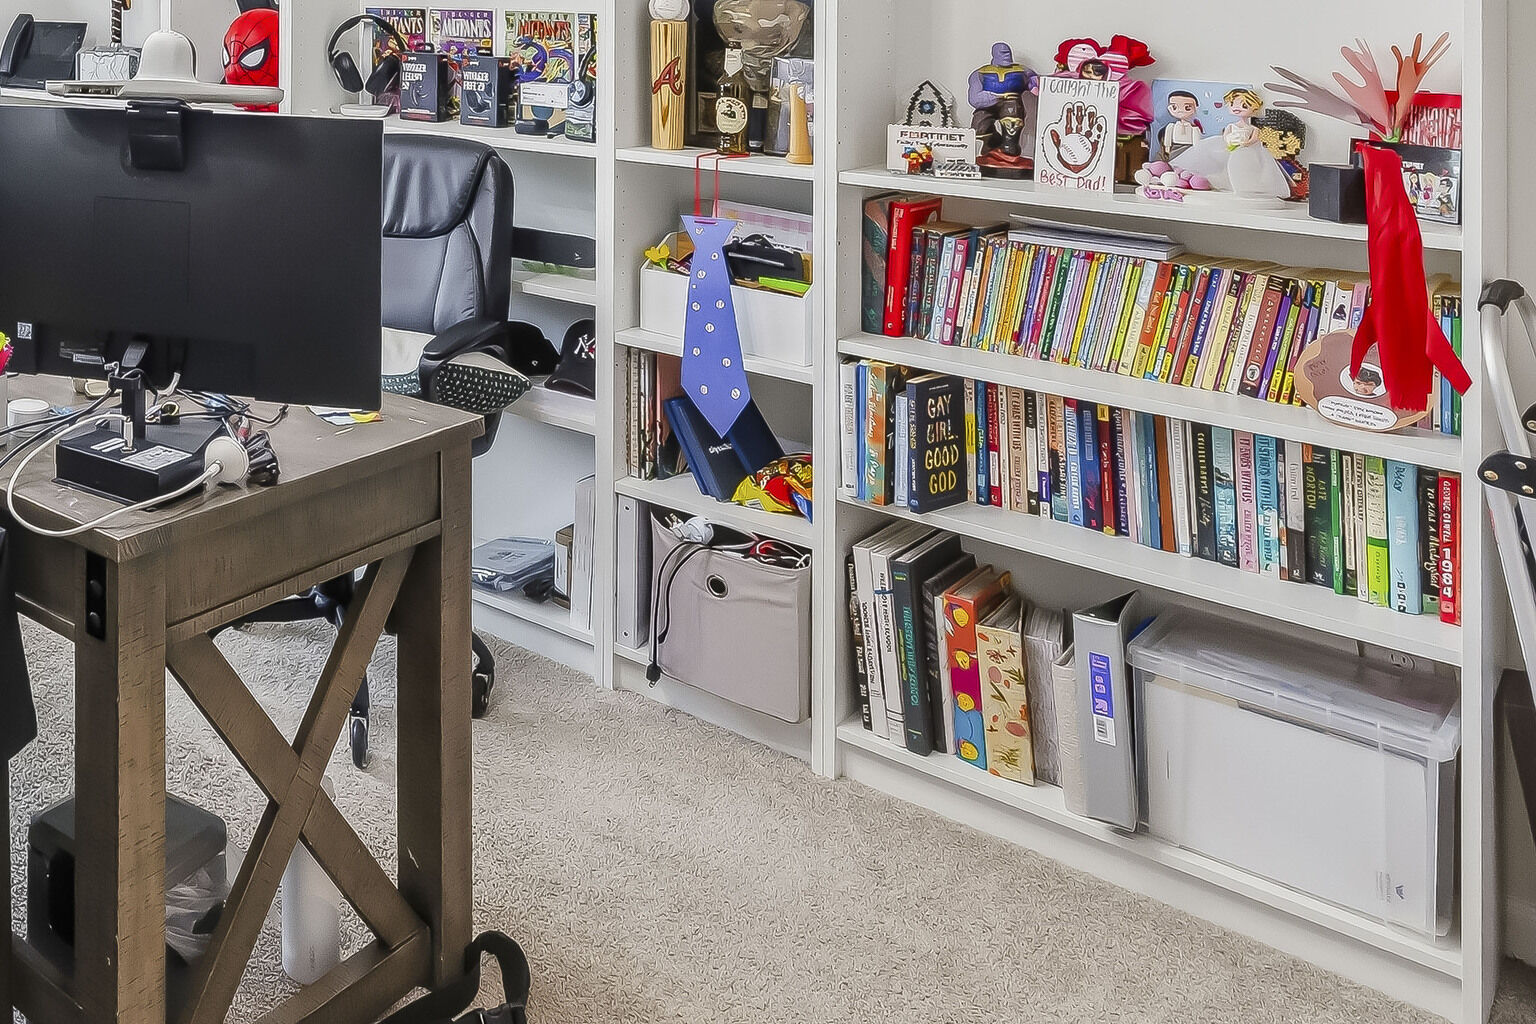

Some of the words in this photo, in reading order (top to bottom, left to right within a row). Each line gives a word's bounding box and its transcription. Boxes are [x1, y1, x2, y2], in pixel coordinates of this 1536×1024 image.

[900, 130, 966, 142] FORTINET
[926, 394, 952, 419] GAY
[924, 445, 959, 470] GOOD
[928, 470, 957, 496] GOD
[1441, 547, 1453, 598] 1984
